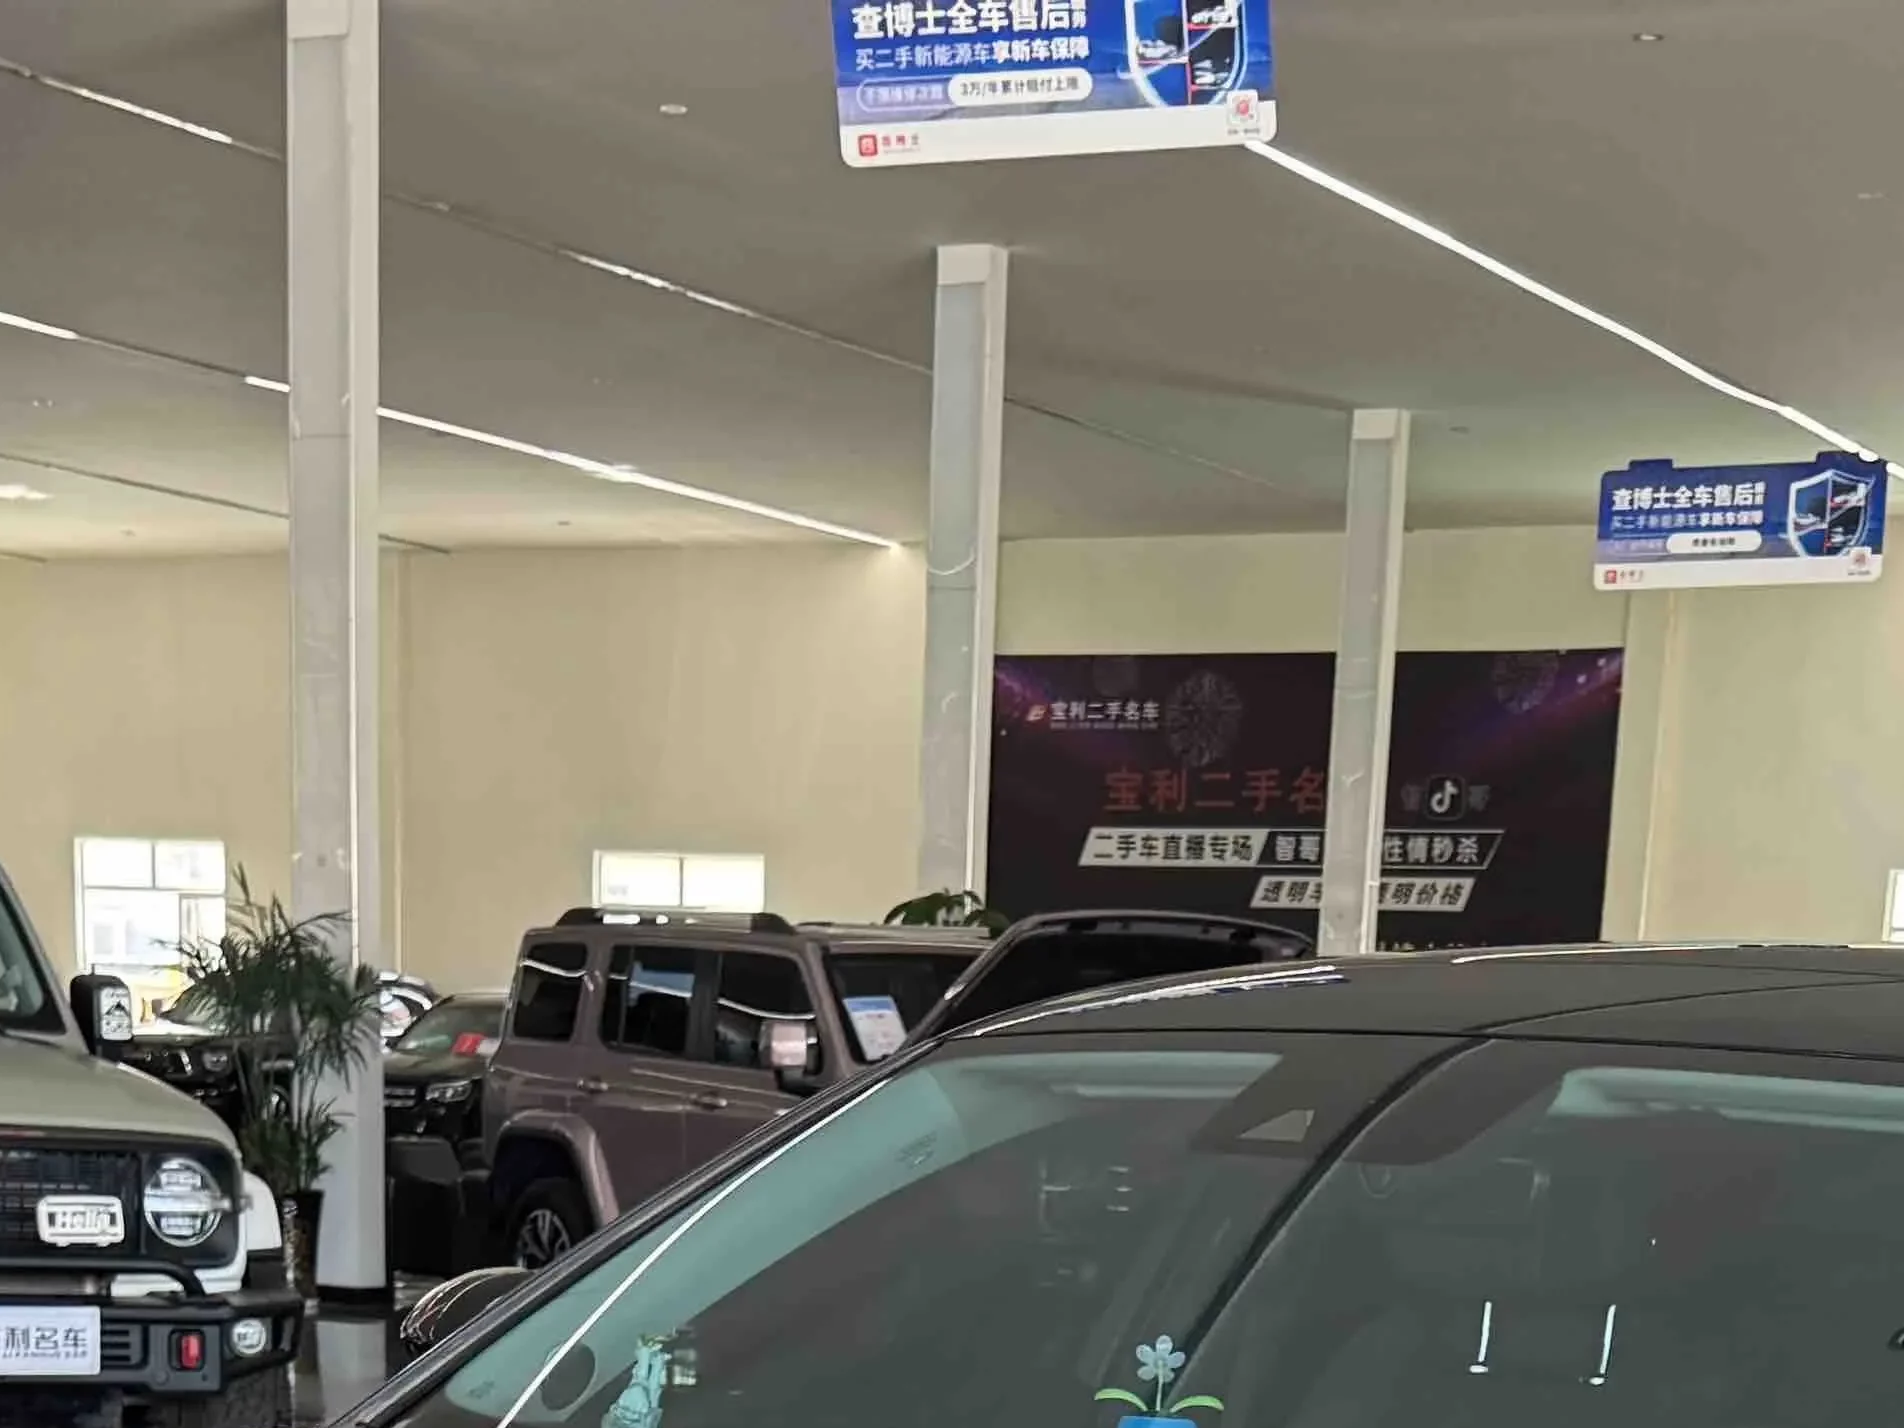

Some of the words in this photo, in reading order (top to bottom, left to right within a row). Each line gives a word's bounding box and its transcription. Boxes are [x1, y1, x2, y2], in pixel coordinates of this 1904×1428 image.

[852, 0, 1071, 39] 查博士全车售后
